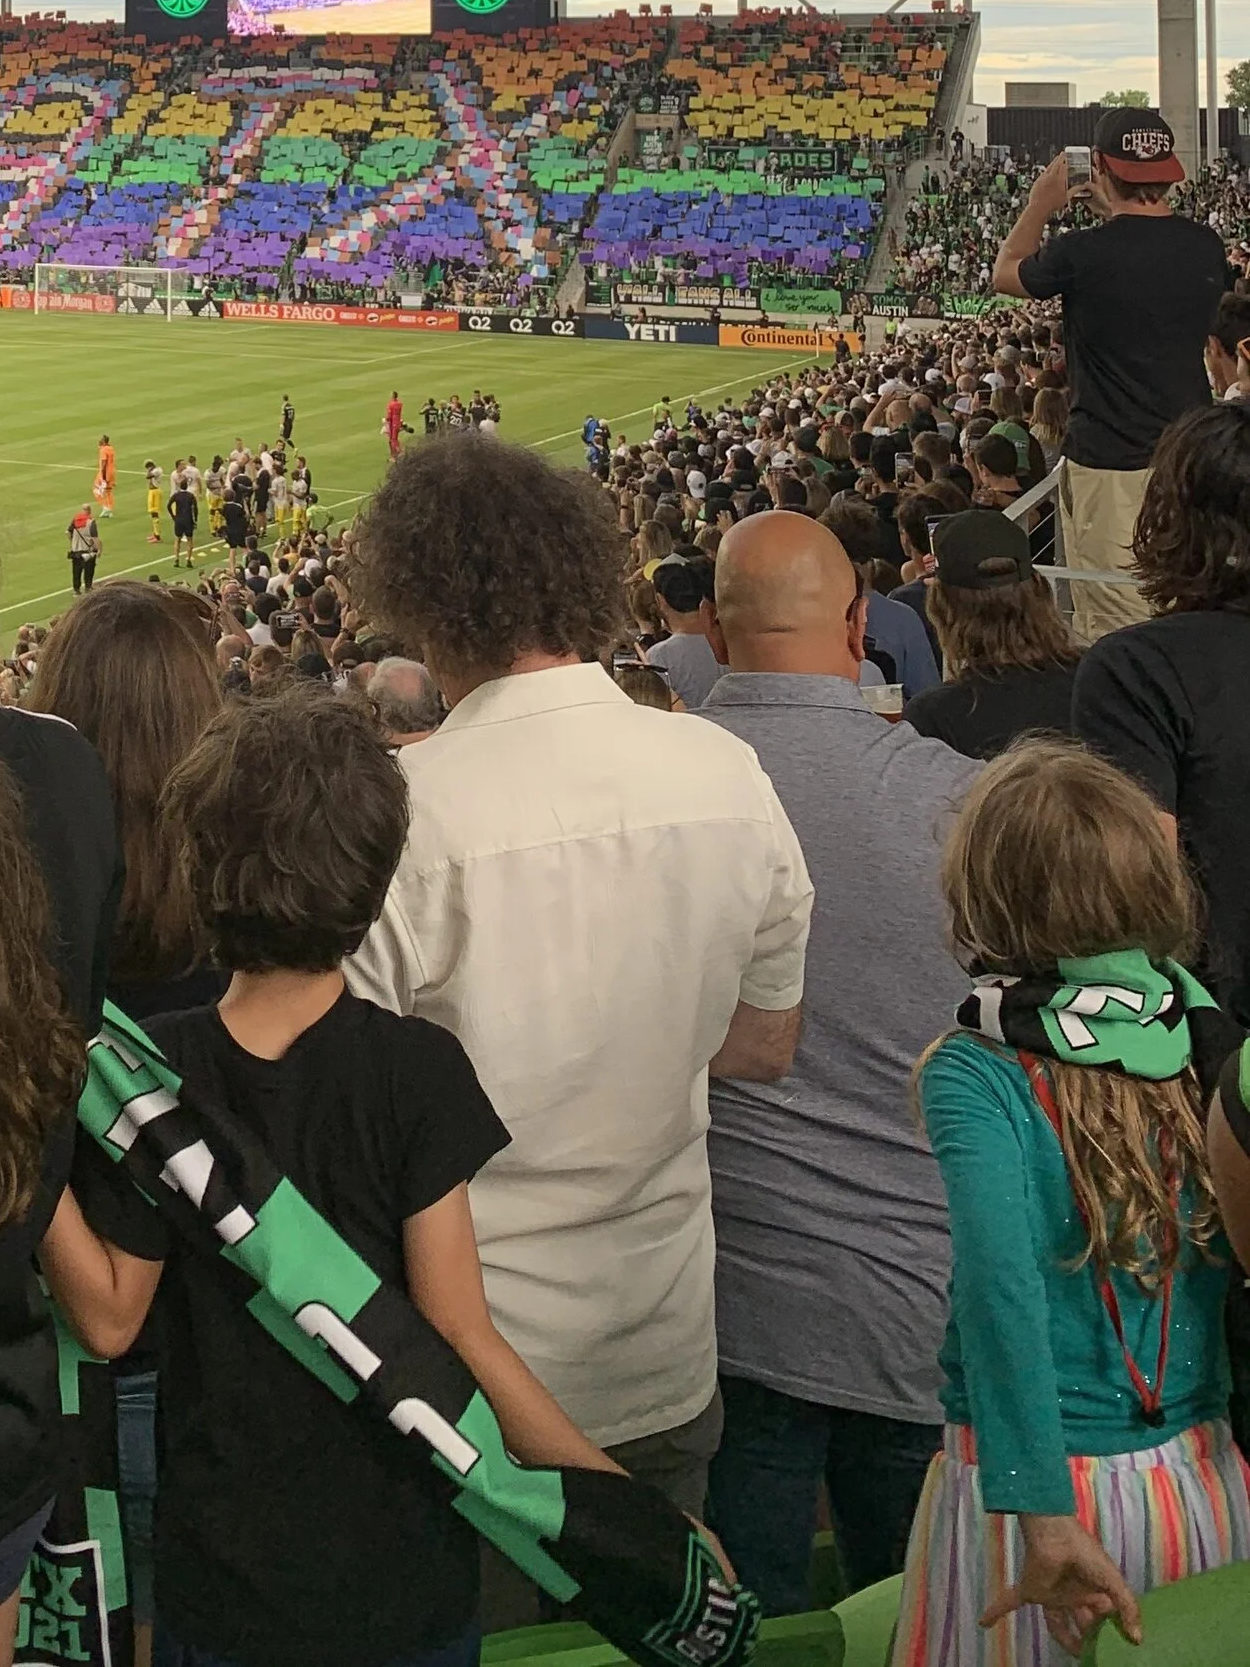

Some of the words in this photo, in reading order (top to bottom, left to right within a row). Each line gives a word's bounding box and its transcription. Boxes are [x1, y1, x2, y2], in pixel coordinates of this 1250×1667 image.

[1122, 132, 1170, 152] CHIEFS
[226, 302, 279, 318] WELLS
[282, 305, 336, 322] FARGO
[872, 305, 909, 317] AUSTIN
[468, 315, 491, 331] Q2
[509, 317, 533, 333] Q2
[551, 320, 575, 335] Q2
[624, 323, 677, 342] YETI
[741, 329, 823, 347] Continental
